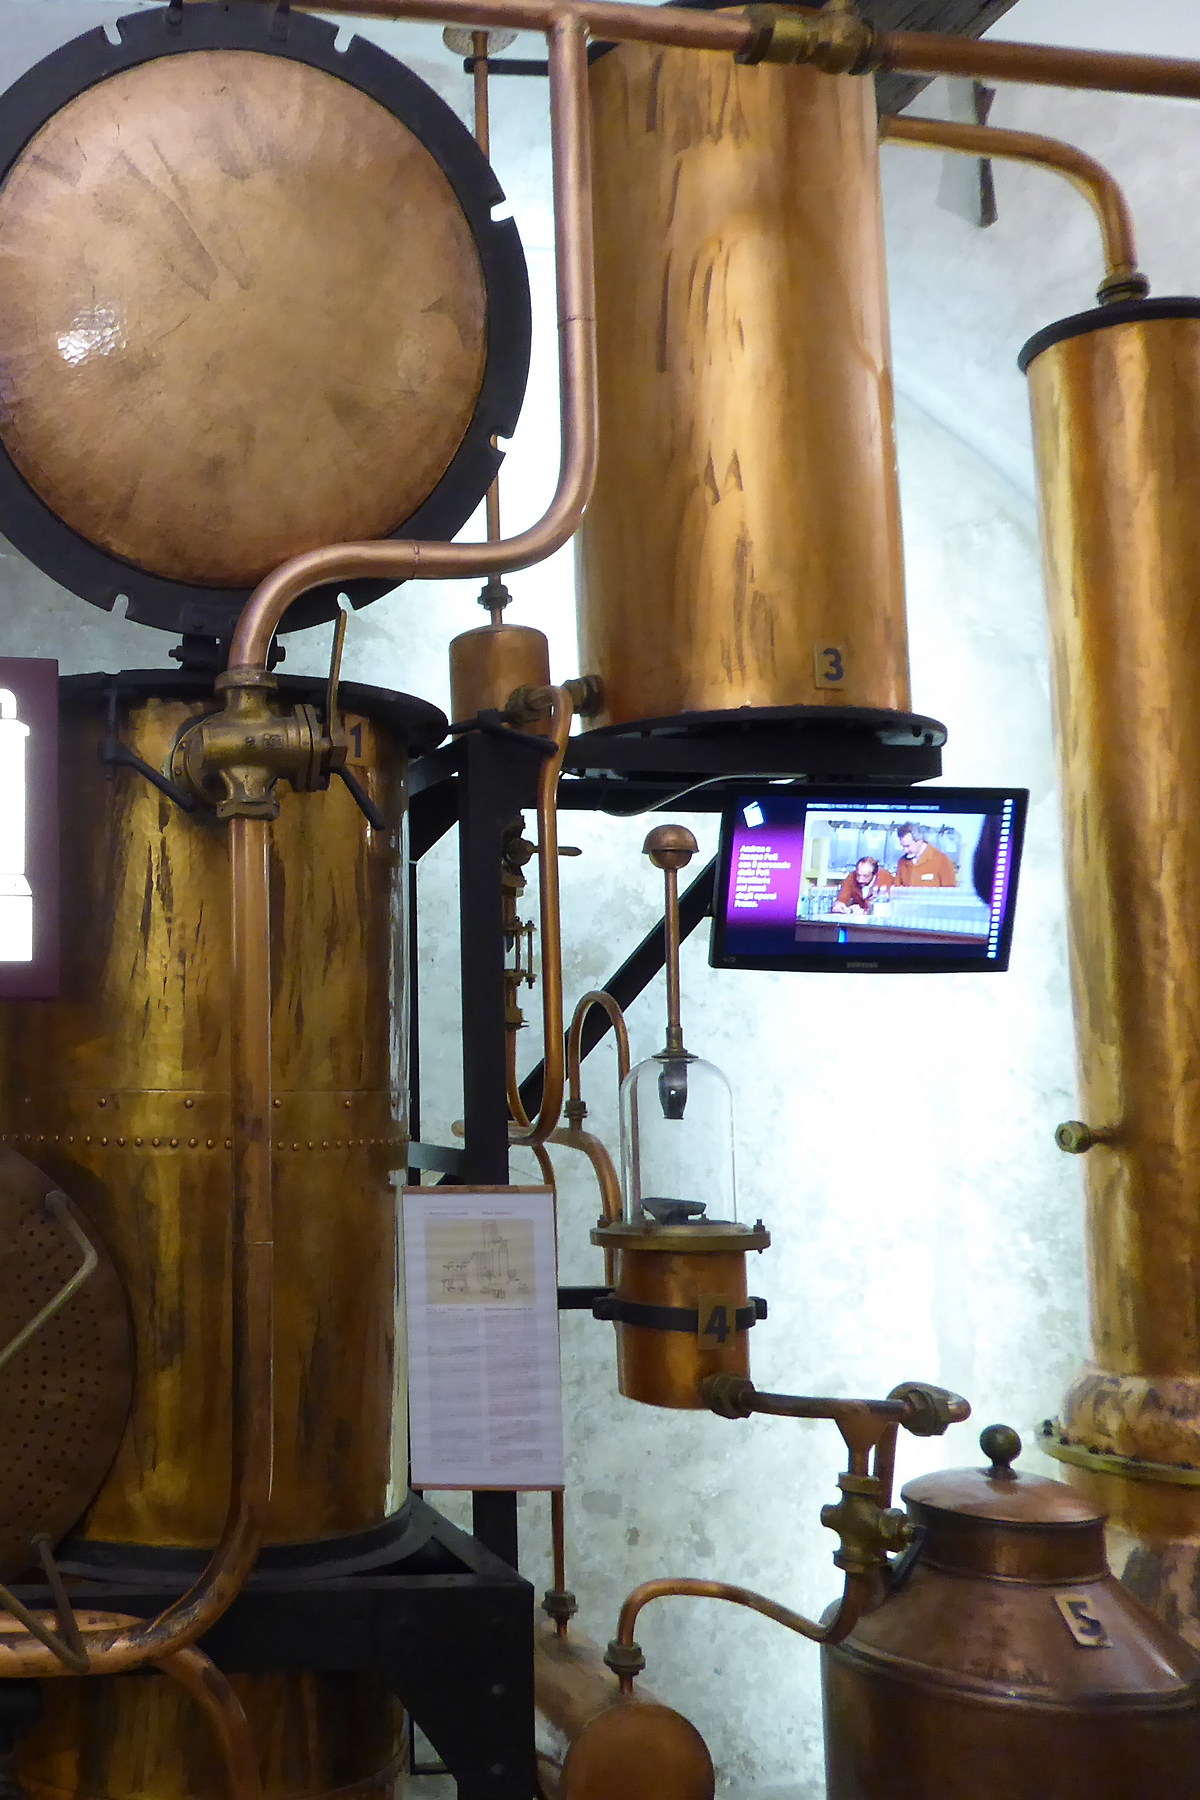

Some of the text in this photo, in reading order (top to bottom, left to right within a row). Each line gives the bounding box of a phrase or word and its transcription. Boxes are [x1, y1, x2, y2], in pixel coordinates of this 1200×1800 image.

[822, 647, 844, 682] 3
[349, 721, 363, 758] 1
[703, 1305, 731, 1343] 4
[1066, 1601, 1102, 1636] 5
